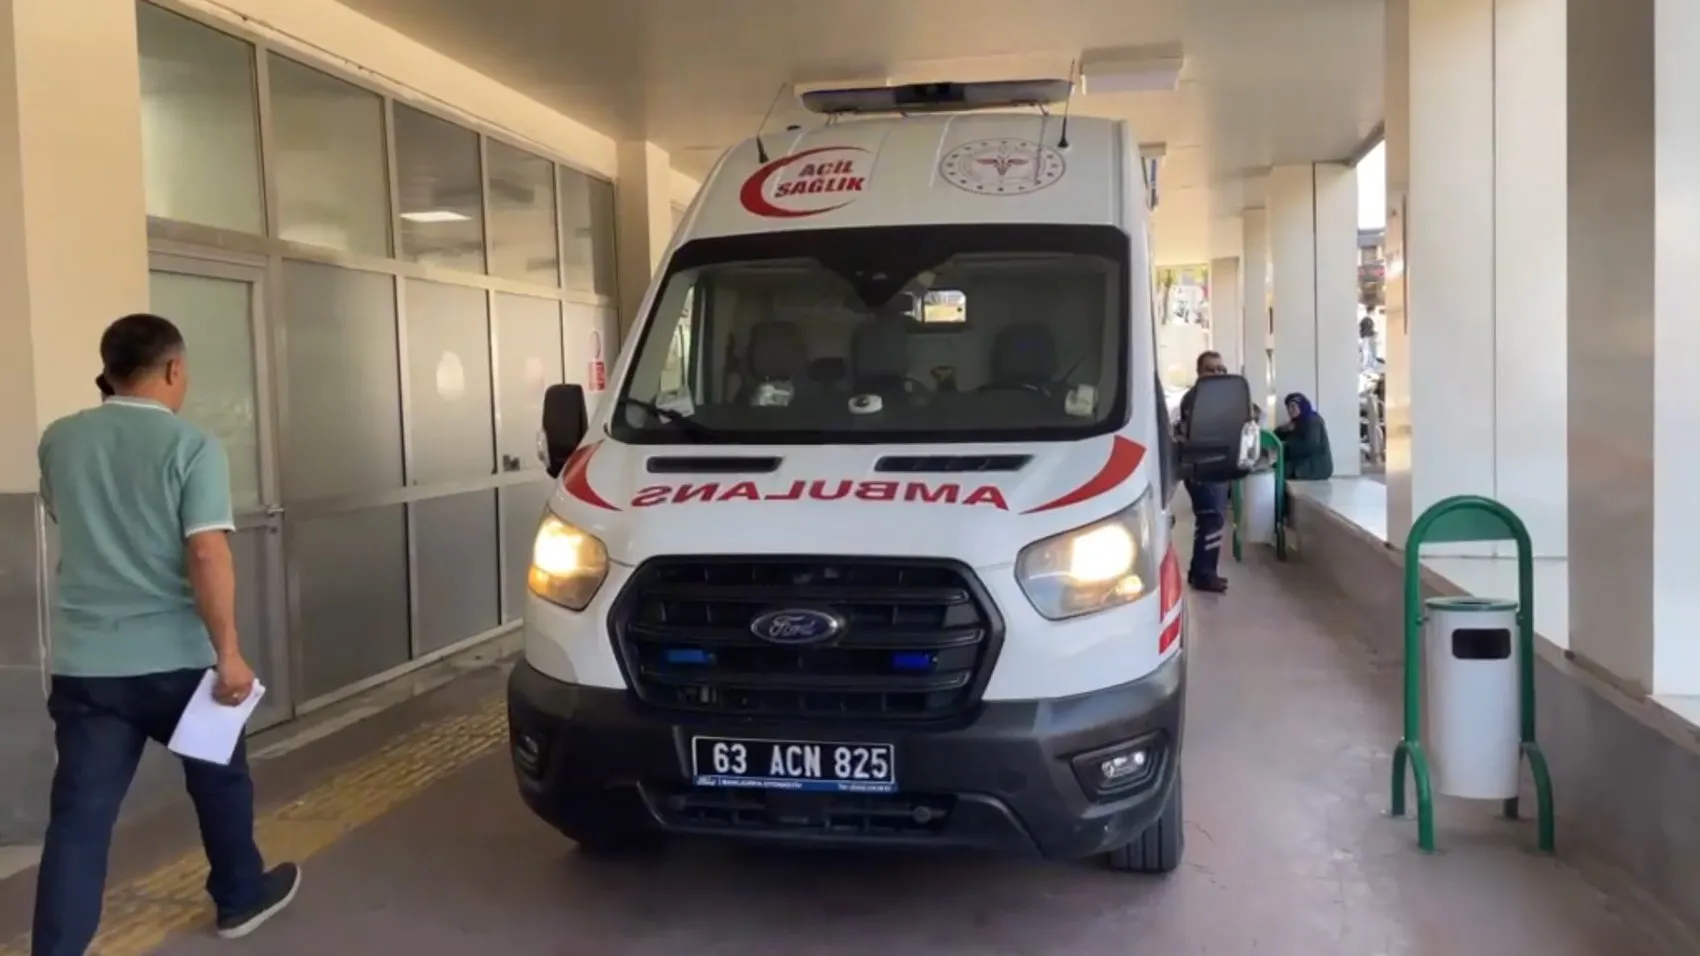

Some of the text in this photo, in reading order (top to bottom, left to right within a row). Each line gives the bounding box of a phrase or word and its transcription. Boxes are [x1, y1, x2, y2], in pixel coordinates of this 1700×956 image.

[769, 614, 816, 637] Ford
[713, 742, 888, 779] 63 ACN 825
